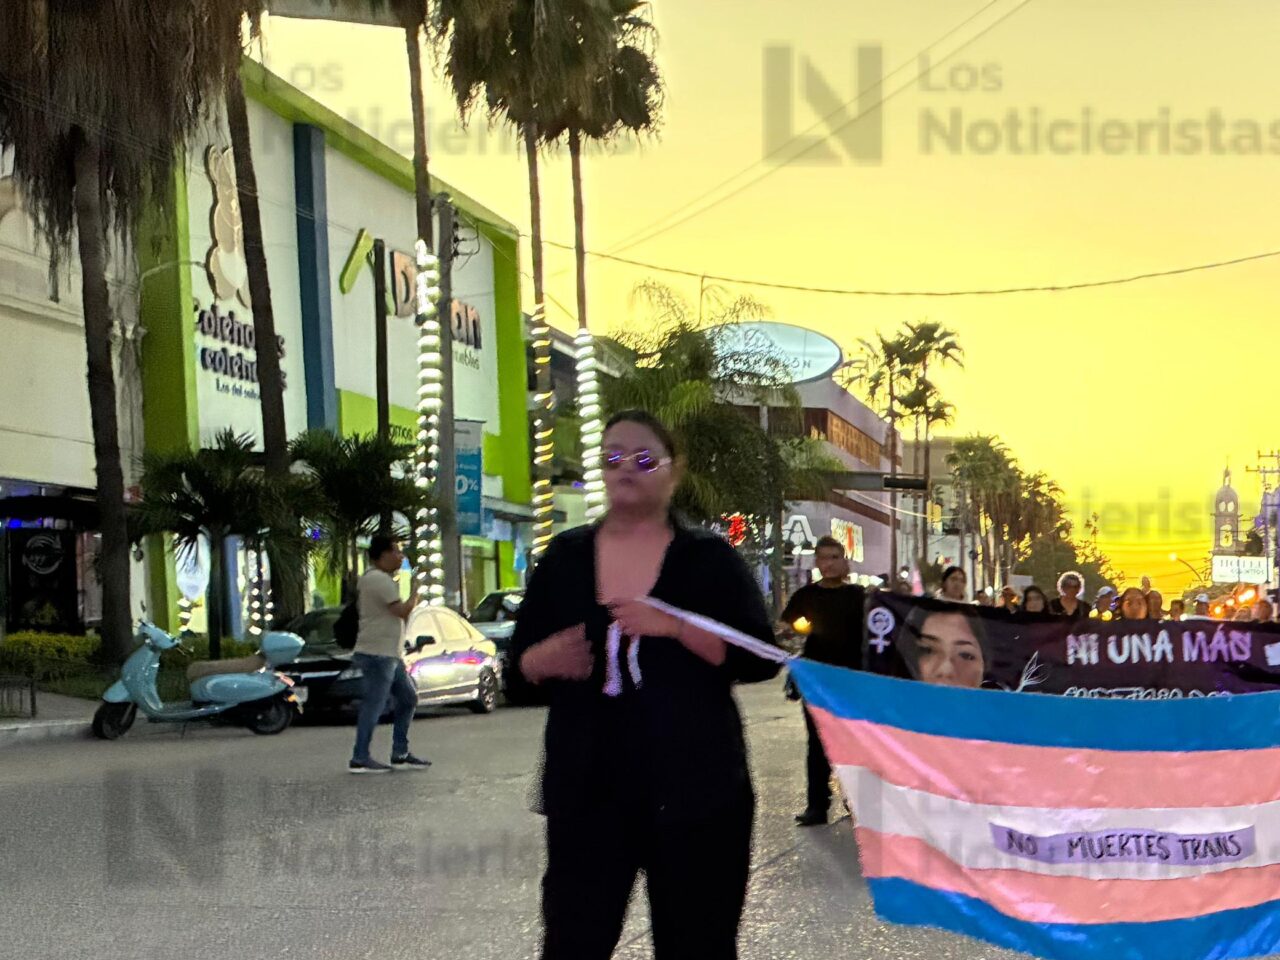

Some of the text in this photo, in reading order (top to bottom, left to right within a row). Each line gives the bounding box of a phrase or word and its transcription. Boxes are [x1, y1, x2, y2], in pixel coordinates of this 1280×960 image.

[1066, 624, 1252, 665] NI UNA MÁS
[1006, 830, 1243, 861] NO MUERTES TRANS
